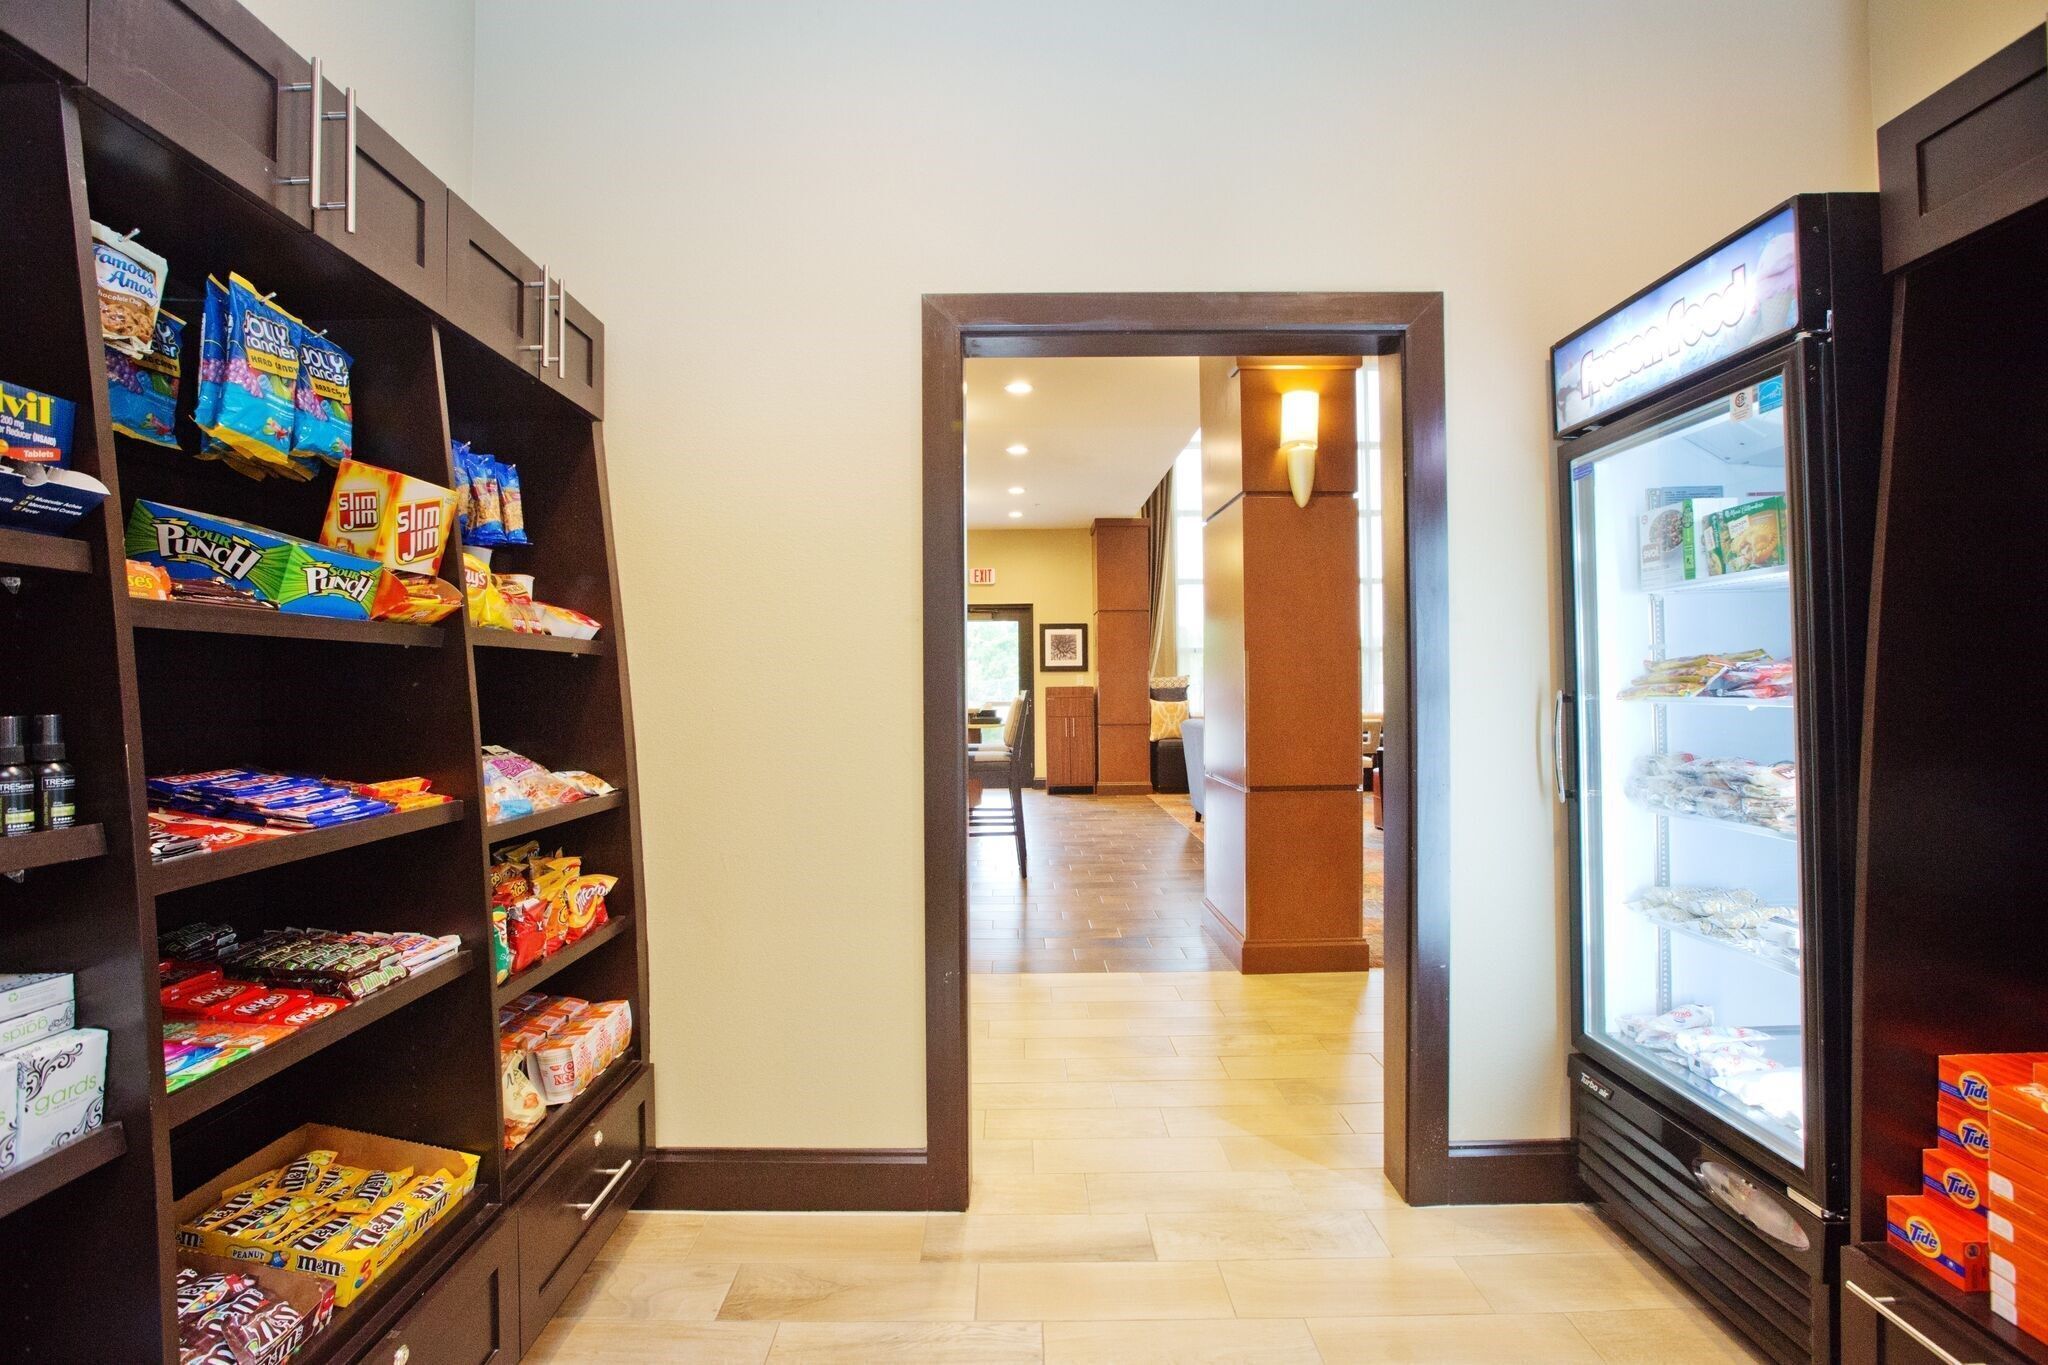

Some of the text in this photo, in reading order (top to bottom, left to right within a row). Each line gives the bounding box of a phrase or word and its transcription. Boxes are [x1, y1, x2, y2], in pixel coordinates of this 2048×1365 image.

[108, 270, 155, 299] Amos
[1668, 264, 1746, 356] food
[244, 311, 286, 346] JOLLY
[246, 337, 297, 359] rancher
[303, 347, 343, 374] JOLLY
[24, 450, 54, 459] Tablets
[339, 489, 377, 511] slim
[343, 510, 378, 530] jim
[397, 503, 440, 533] slim
[186, 526, 232, 547] SOUR
[402, 526, 438, 562] jim
[152, 523, 263, 581] PUNCH
[303, 567, 374, 601] PUNCH
[330, 566, 360, 579] SOUR
[974, 569, 992, 583] EXIT
[35, 1075, 97, 1116] gards
[1580, 1072, 1609, 1098] Turbo air
[1963, 1126, 1989, 1149] Tide
[1947, 1175, 1976, 1199] Tide
[1909, 1222, 1938, 1248] Tide
[232, 1250, 265, 1260] PEANUT
